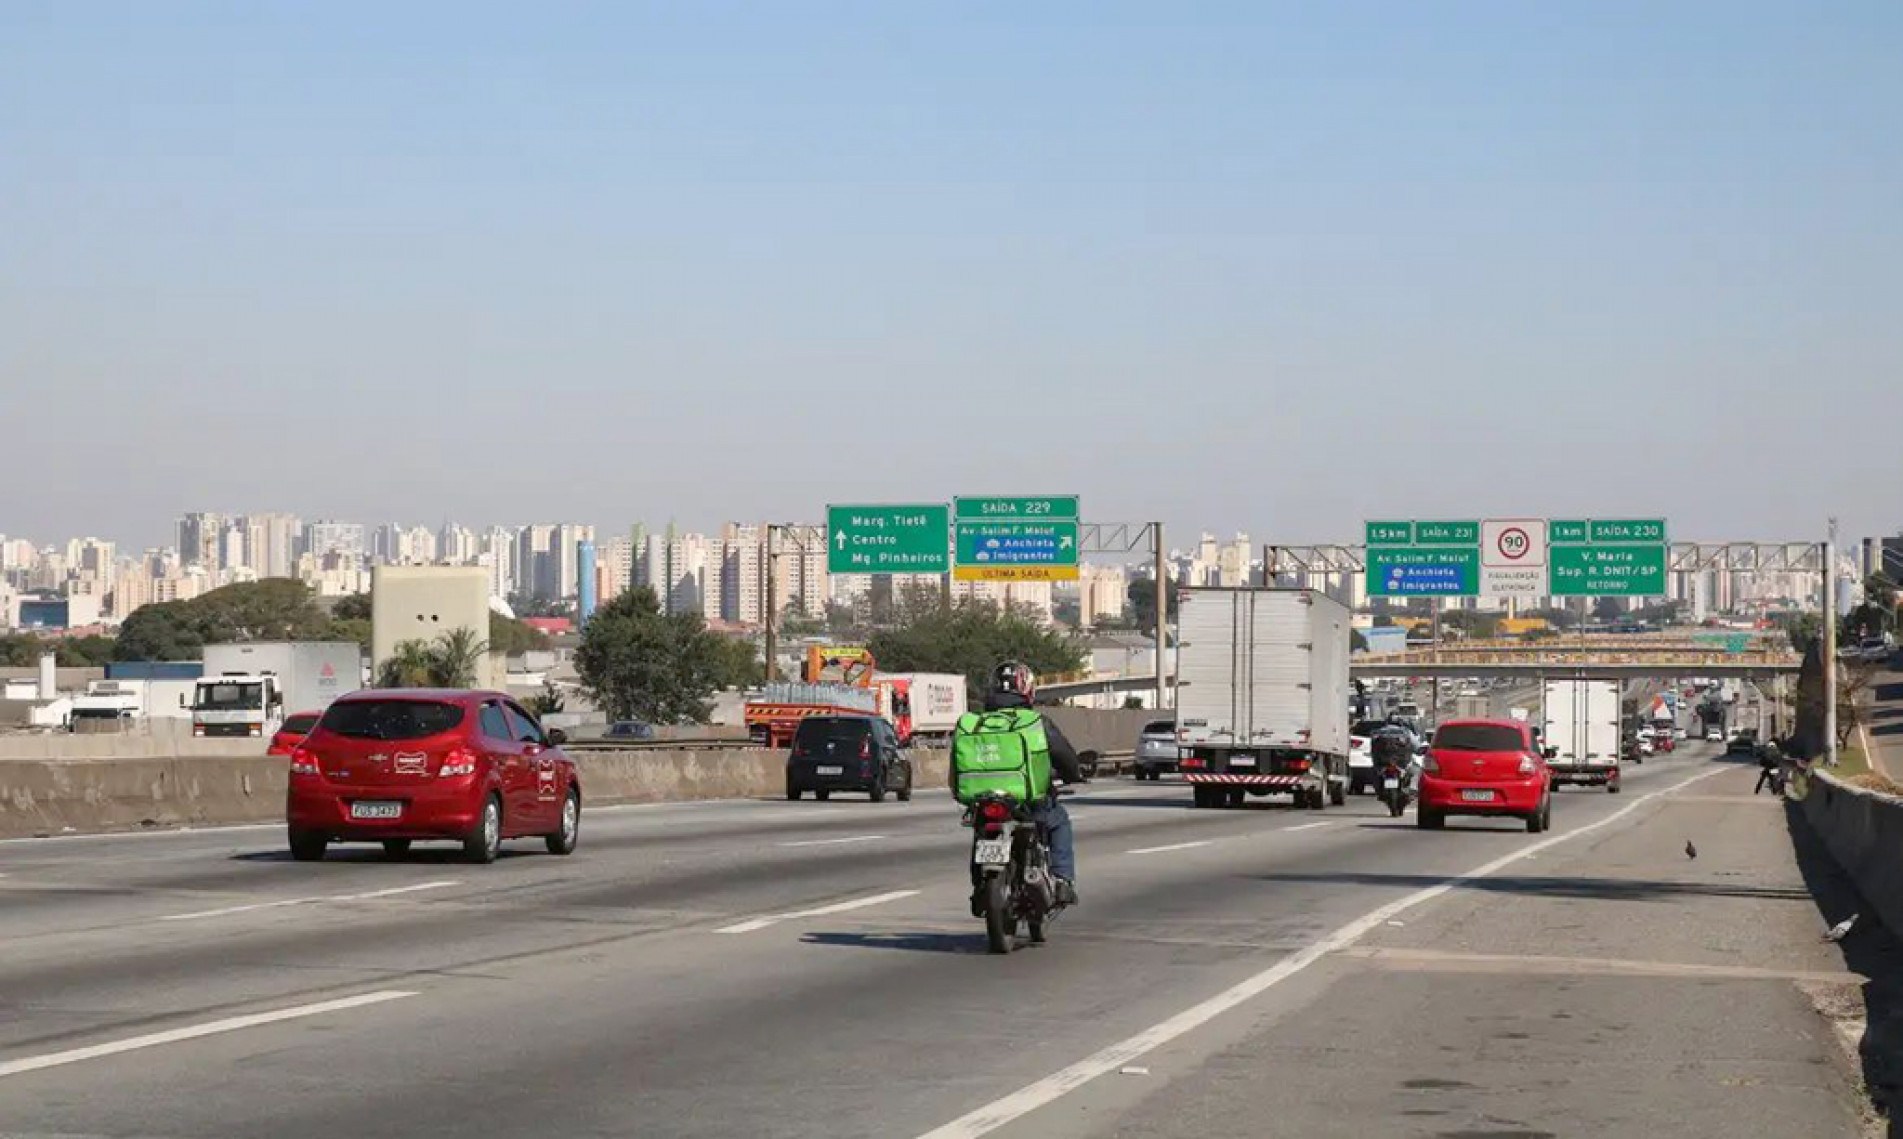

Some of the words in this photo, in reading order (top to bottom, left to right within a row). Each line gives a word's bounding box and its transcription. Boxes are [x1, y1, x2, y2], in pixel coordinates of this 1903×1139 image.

[982, 500, 1017, 514] SAÍDA
[1025, 501, 1051, 514] 229
[852, 515, 889, 529] Marq.
[893, 514, 927, 527] Tietê
[1389, 528, 1406, 539] km
[1422, 525, 1450, 538] SAÍDA
[1454, 527, 1473, 539] 231
[1562, 527, 1581, 536] km
[1596, 524, 1630, 536] SAÍDA
[1633, 525, 1659, 537] 230
[852, 534, 897, 545] Centro
[1004, 539, 1055, 548] Anchieta
[1505, 536, 1524, 549] 90
[879, 552, 943, 564] Pinheiros
[993, 551, 1055, 561] Imigrantes
[1439, 554, 1469, 563] Maluf
[1581, 551, 1594, 561] V.
[1597, 551, 1634, 561] Maria
[1408, 567, 1455, 577] Anchieta
[1557, 565, 1585, 577] Sup.
[1402, 581, 1460, 591] Imigrantes
[1586, 580, 1629, 590] RETORNO
